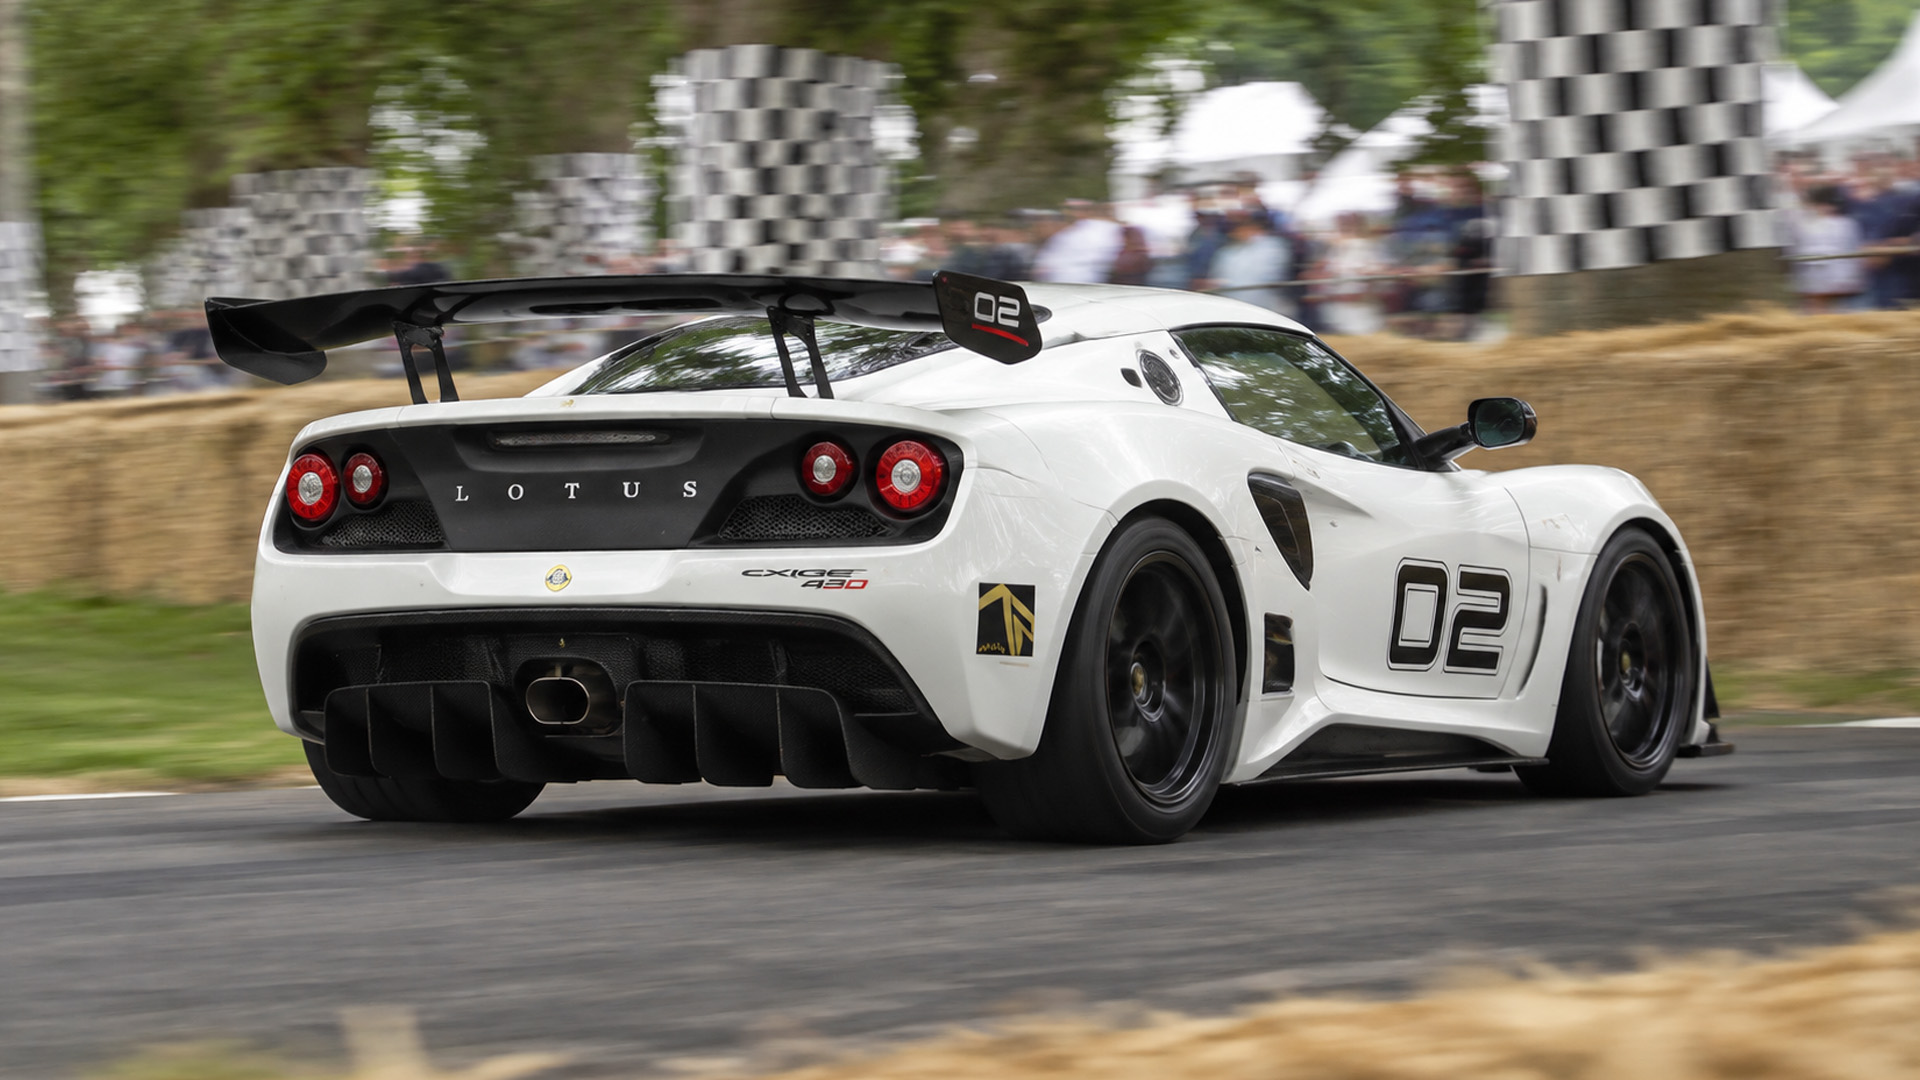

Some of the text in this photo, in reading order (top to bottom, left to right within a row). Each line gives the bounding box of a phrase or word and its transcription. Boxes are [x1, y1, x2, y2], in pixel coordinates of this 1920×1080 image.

[974, 291, 1020, 328] 02
[455, 481, 697, 501] LOTUS
[801, 579, 868, 589] 430
[1387, 557, 1512, 676] 02
